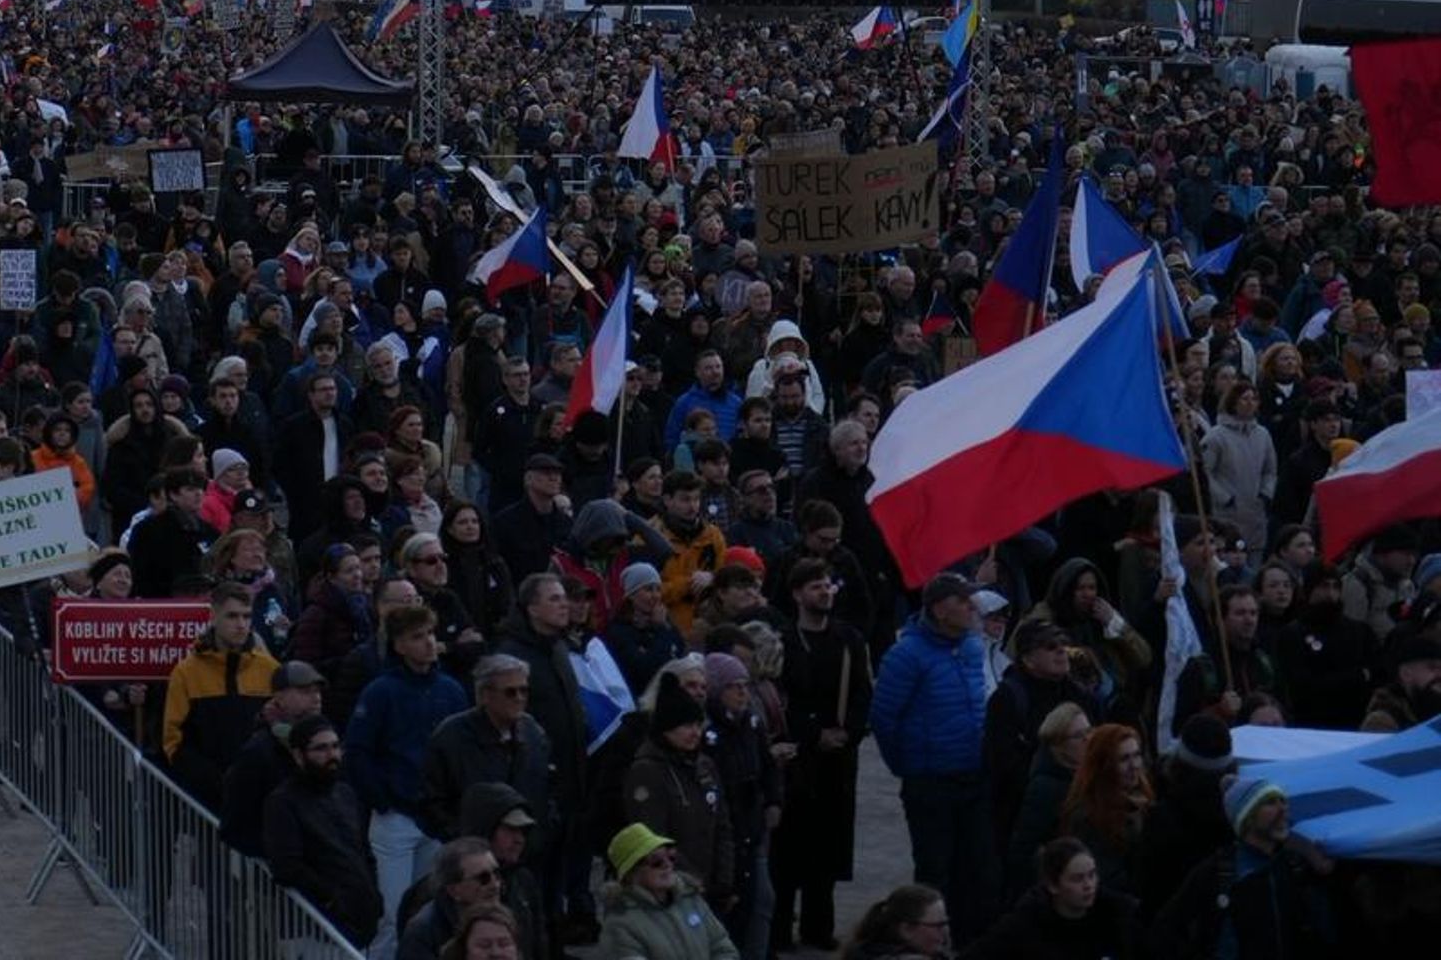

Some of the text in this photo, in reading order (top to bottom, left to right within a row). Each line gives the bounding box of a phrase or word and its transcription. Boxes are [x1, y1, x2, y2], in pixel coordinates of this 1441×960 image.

[758, 160, 852, 197] TUREK
[763, 172, 936, 244] ŠÁLEK KÁVY!
[15, 541, 68, 565] TADY
[64, 621, 124, 639] KOBLIHY
[129, 617, 174, 640] VŠECH
[72, 643, 127, 665] VYLIŽTE
[130, 647, 146, 664] SI
